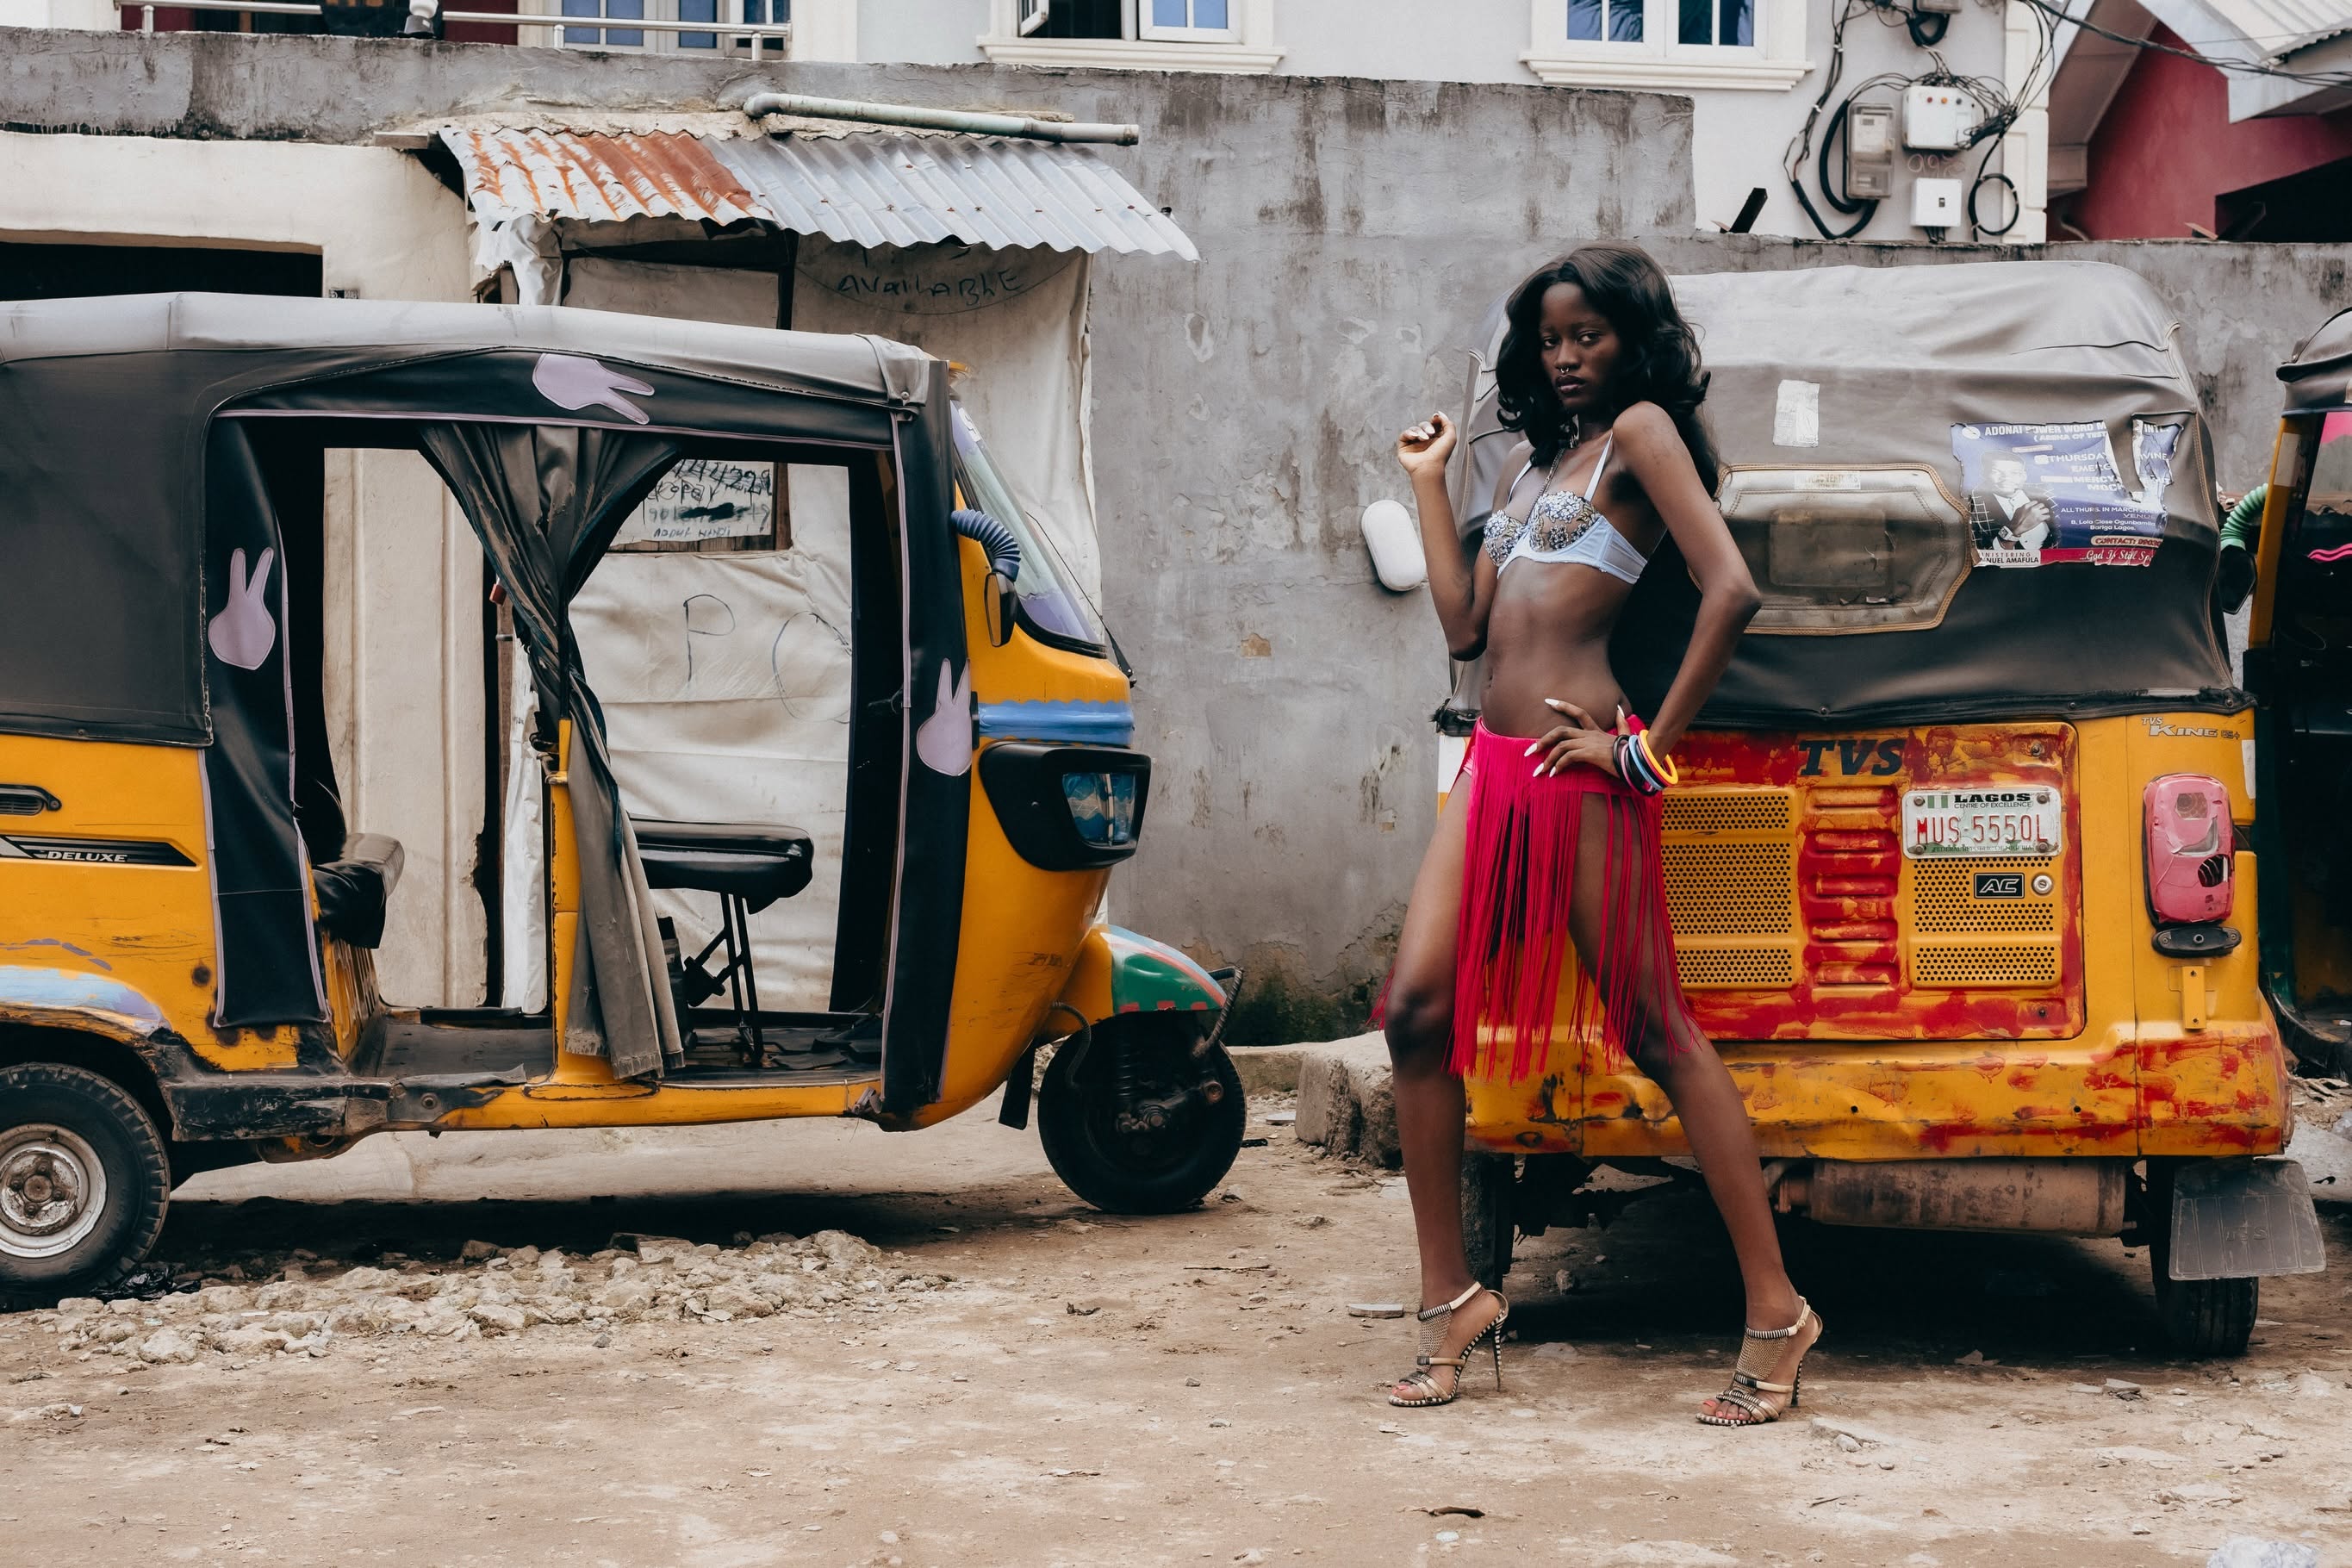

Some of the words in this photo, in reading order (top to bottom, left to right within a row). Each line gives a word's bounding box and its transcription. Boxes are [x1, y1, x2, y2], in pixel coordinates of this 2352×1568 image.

[1984, 426, 2023, 436] ADONAI
[2064, 423, 2094, 432] WORD
[1798, 738, 1907, 775] TVS
[1954, 793, 2031, 803] LAGOS
[46, 850, 128, 862] DELUXE
[1979, 878, 2020, 893] AC
